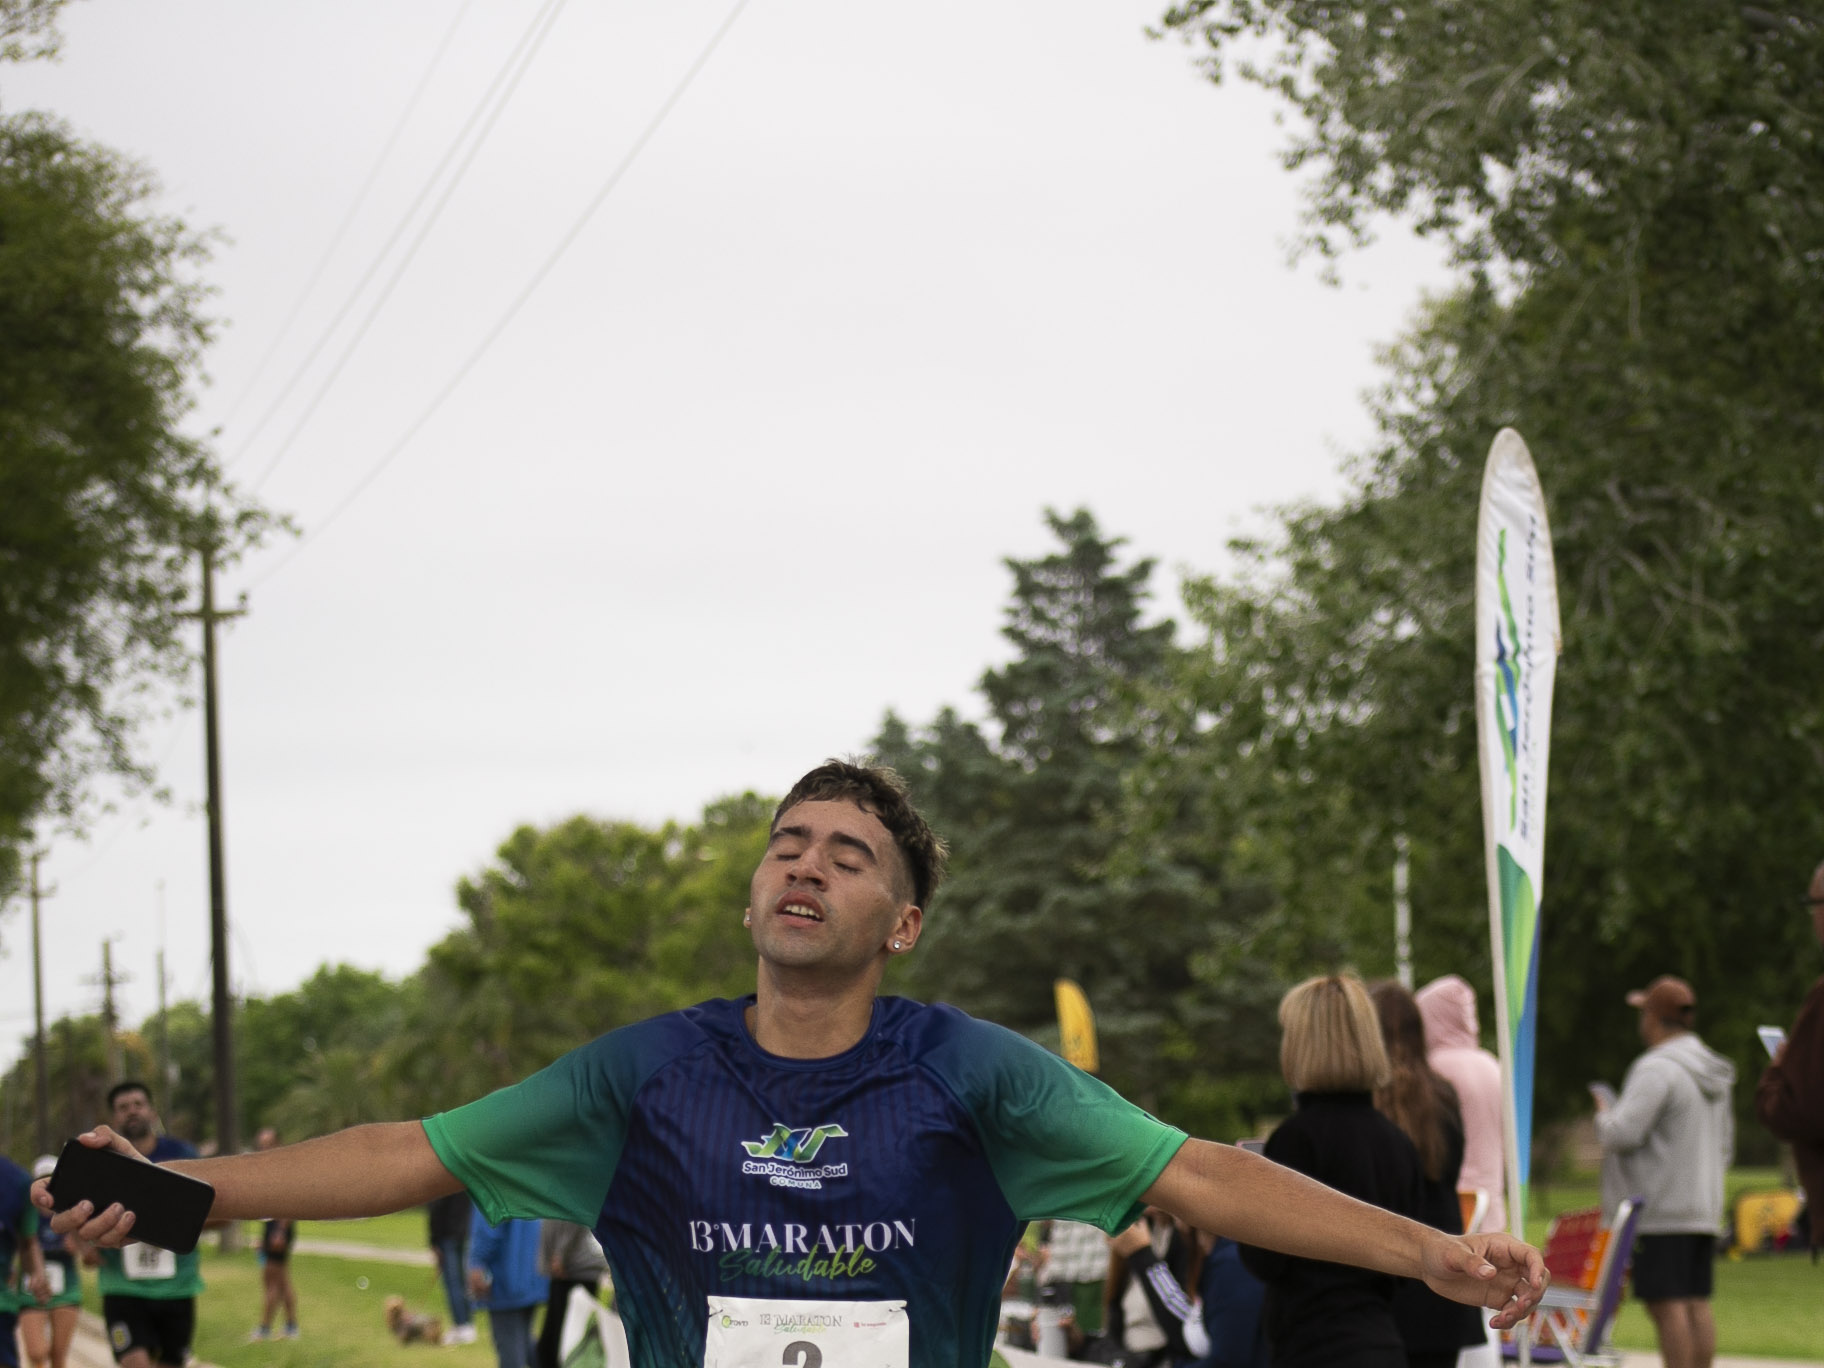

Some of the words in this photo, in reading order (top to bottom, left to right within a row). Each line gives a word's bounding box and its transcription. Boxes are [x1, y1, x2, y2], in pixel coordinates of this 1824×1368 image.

[743, 1161, 767, 1174] San
[768, 1162, 822, 1178] Jerónimo
[823, 1163, 847, 1178] Sud
[770, 1177, 821, 1189] COMUNA
[720, 1218, 916, 1253] MARATON
[719, 1244, 877, 1282] Saludable
[775, 1314, 842, 1327] MARATON
